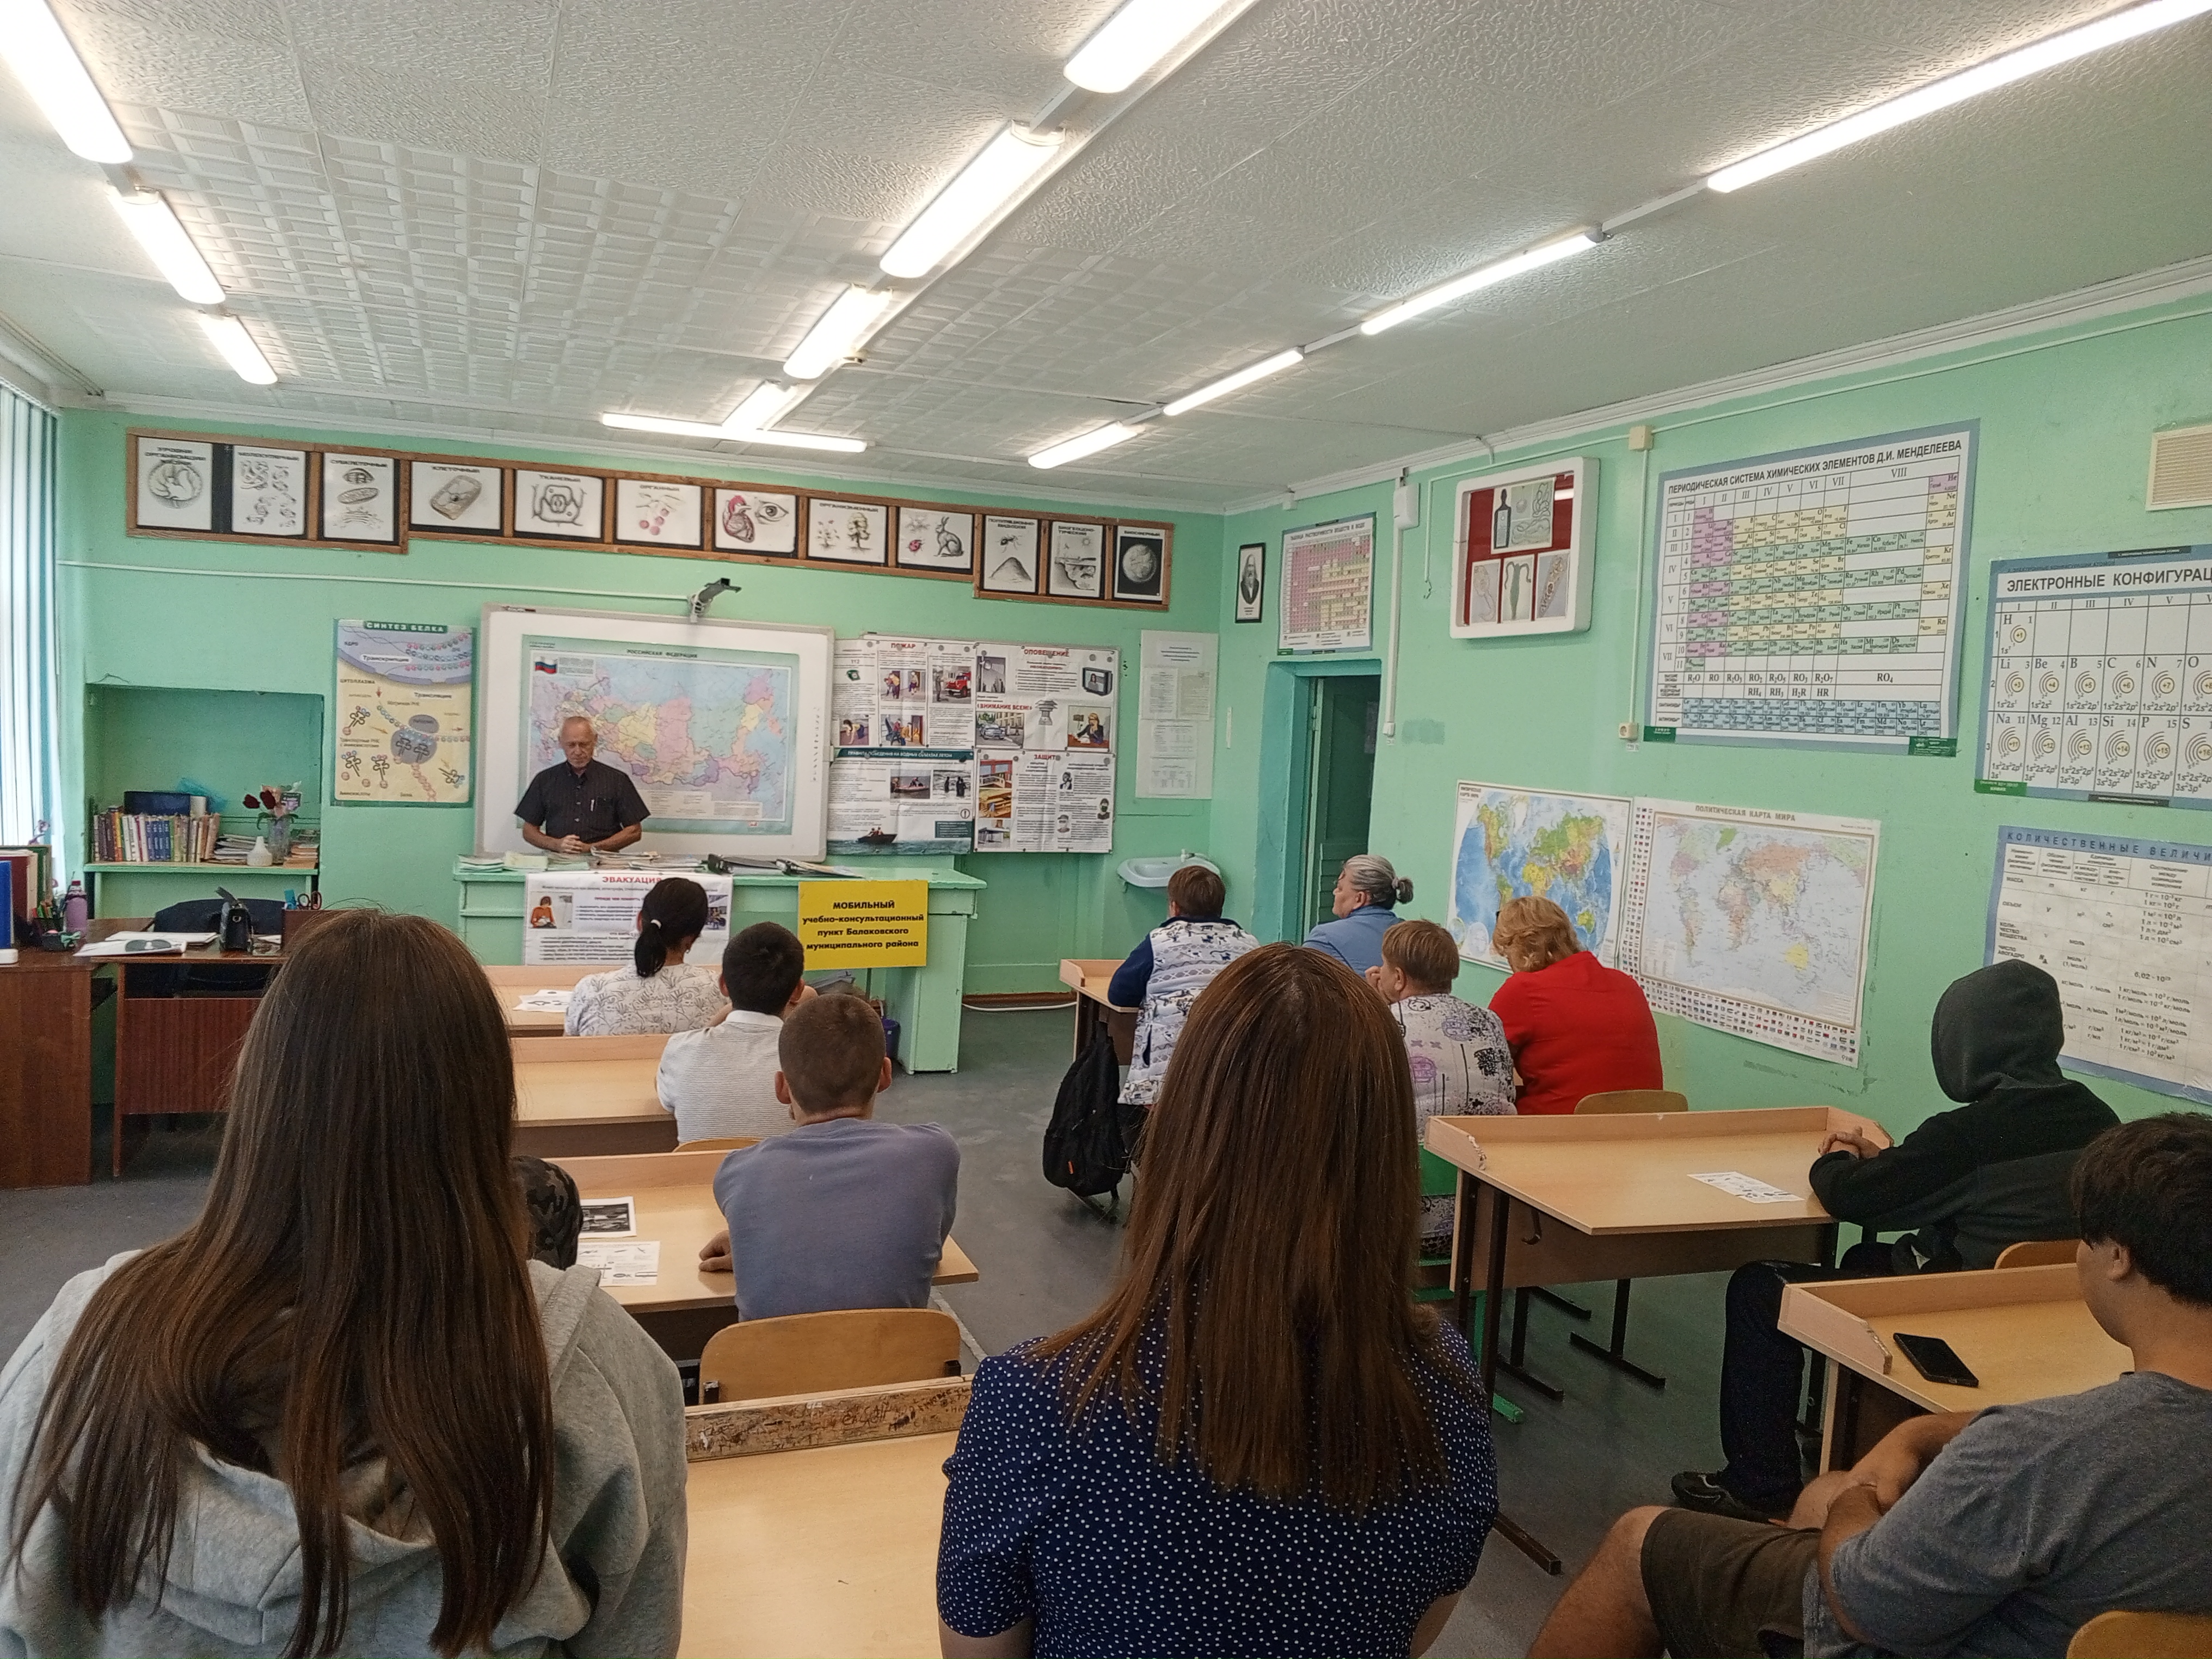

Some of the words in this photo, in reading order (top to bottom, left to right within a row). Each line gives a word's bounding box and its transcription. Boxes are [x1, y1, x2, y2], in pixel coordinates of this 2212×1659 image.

[1668, 477, 1728, 494] ПЕРИОДИЧЕСКАЯ
[1730, 471, 1765, 484] СИСТЕМА
[1767, 462, 1821, 479] ХИМИЧЕСКИХ
[1823, 453, 1875, 470] ЭЛЕМЕНТОВ
[1877, 451, 1894, 464] Д.И.
[1897, 440, 1961, 459] МЕНДЕЛЕЕВА
[1722, 494, 1727, 502] II
[1764, 487, 1772, 496] IV
[1787, 484, 1793, 493] V
[1809, 480, 1818, 489] VI
[1833, 476, 1844, 486] VII
[1891, 468, 1907, 478] VIII
[1669, 565, 1676, 573] IV
[2007, 574, 2105, 592] ЭЛЕКТРОННЫЕ
[2004, 615, 2012, 624] H
[411, 624, 444, 632] БЕЛКА
[2001, 659, 2010, 668] Li
[2035, 659, 2048, 668] Be
[2070, 658, 2078, 668] B
[2107, 658, 2116, 668] C
[2147, 657, 2157, 667] N
[2177, 660, 2182, 668] 7
[2188, 656, 2199, 667] O
[1817, 688, 1829, 696] HR
[1996, 714, 2010, 724] Na
[2030, 715, 2048, 728] Mg
[2066, 715, 2078, 726] Al
[2103, 716, 2113, 727] Si
[2141, 717, 2149, 727] P
[2182, 718, 2190, 729] S
[1695, 806, 1746, 816] ПОЛИТИЧЕСКАЯ
[1749, 810, 1771, 819] КАРТА
[2007, 832, 2139, 853] КОЛИЧЕСТВЕННЫЕ
[833, 900, 895, 910] МОБИЛЬНЫЙ
[802, 914, 924, 925] учебно-консультационный
[807, 942, 882, 951] муниципального
[886, 941, 919, 949] района
